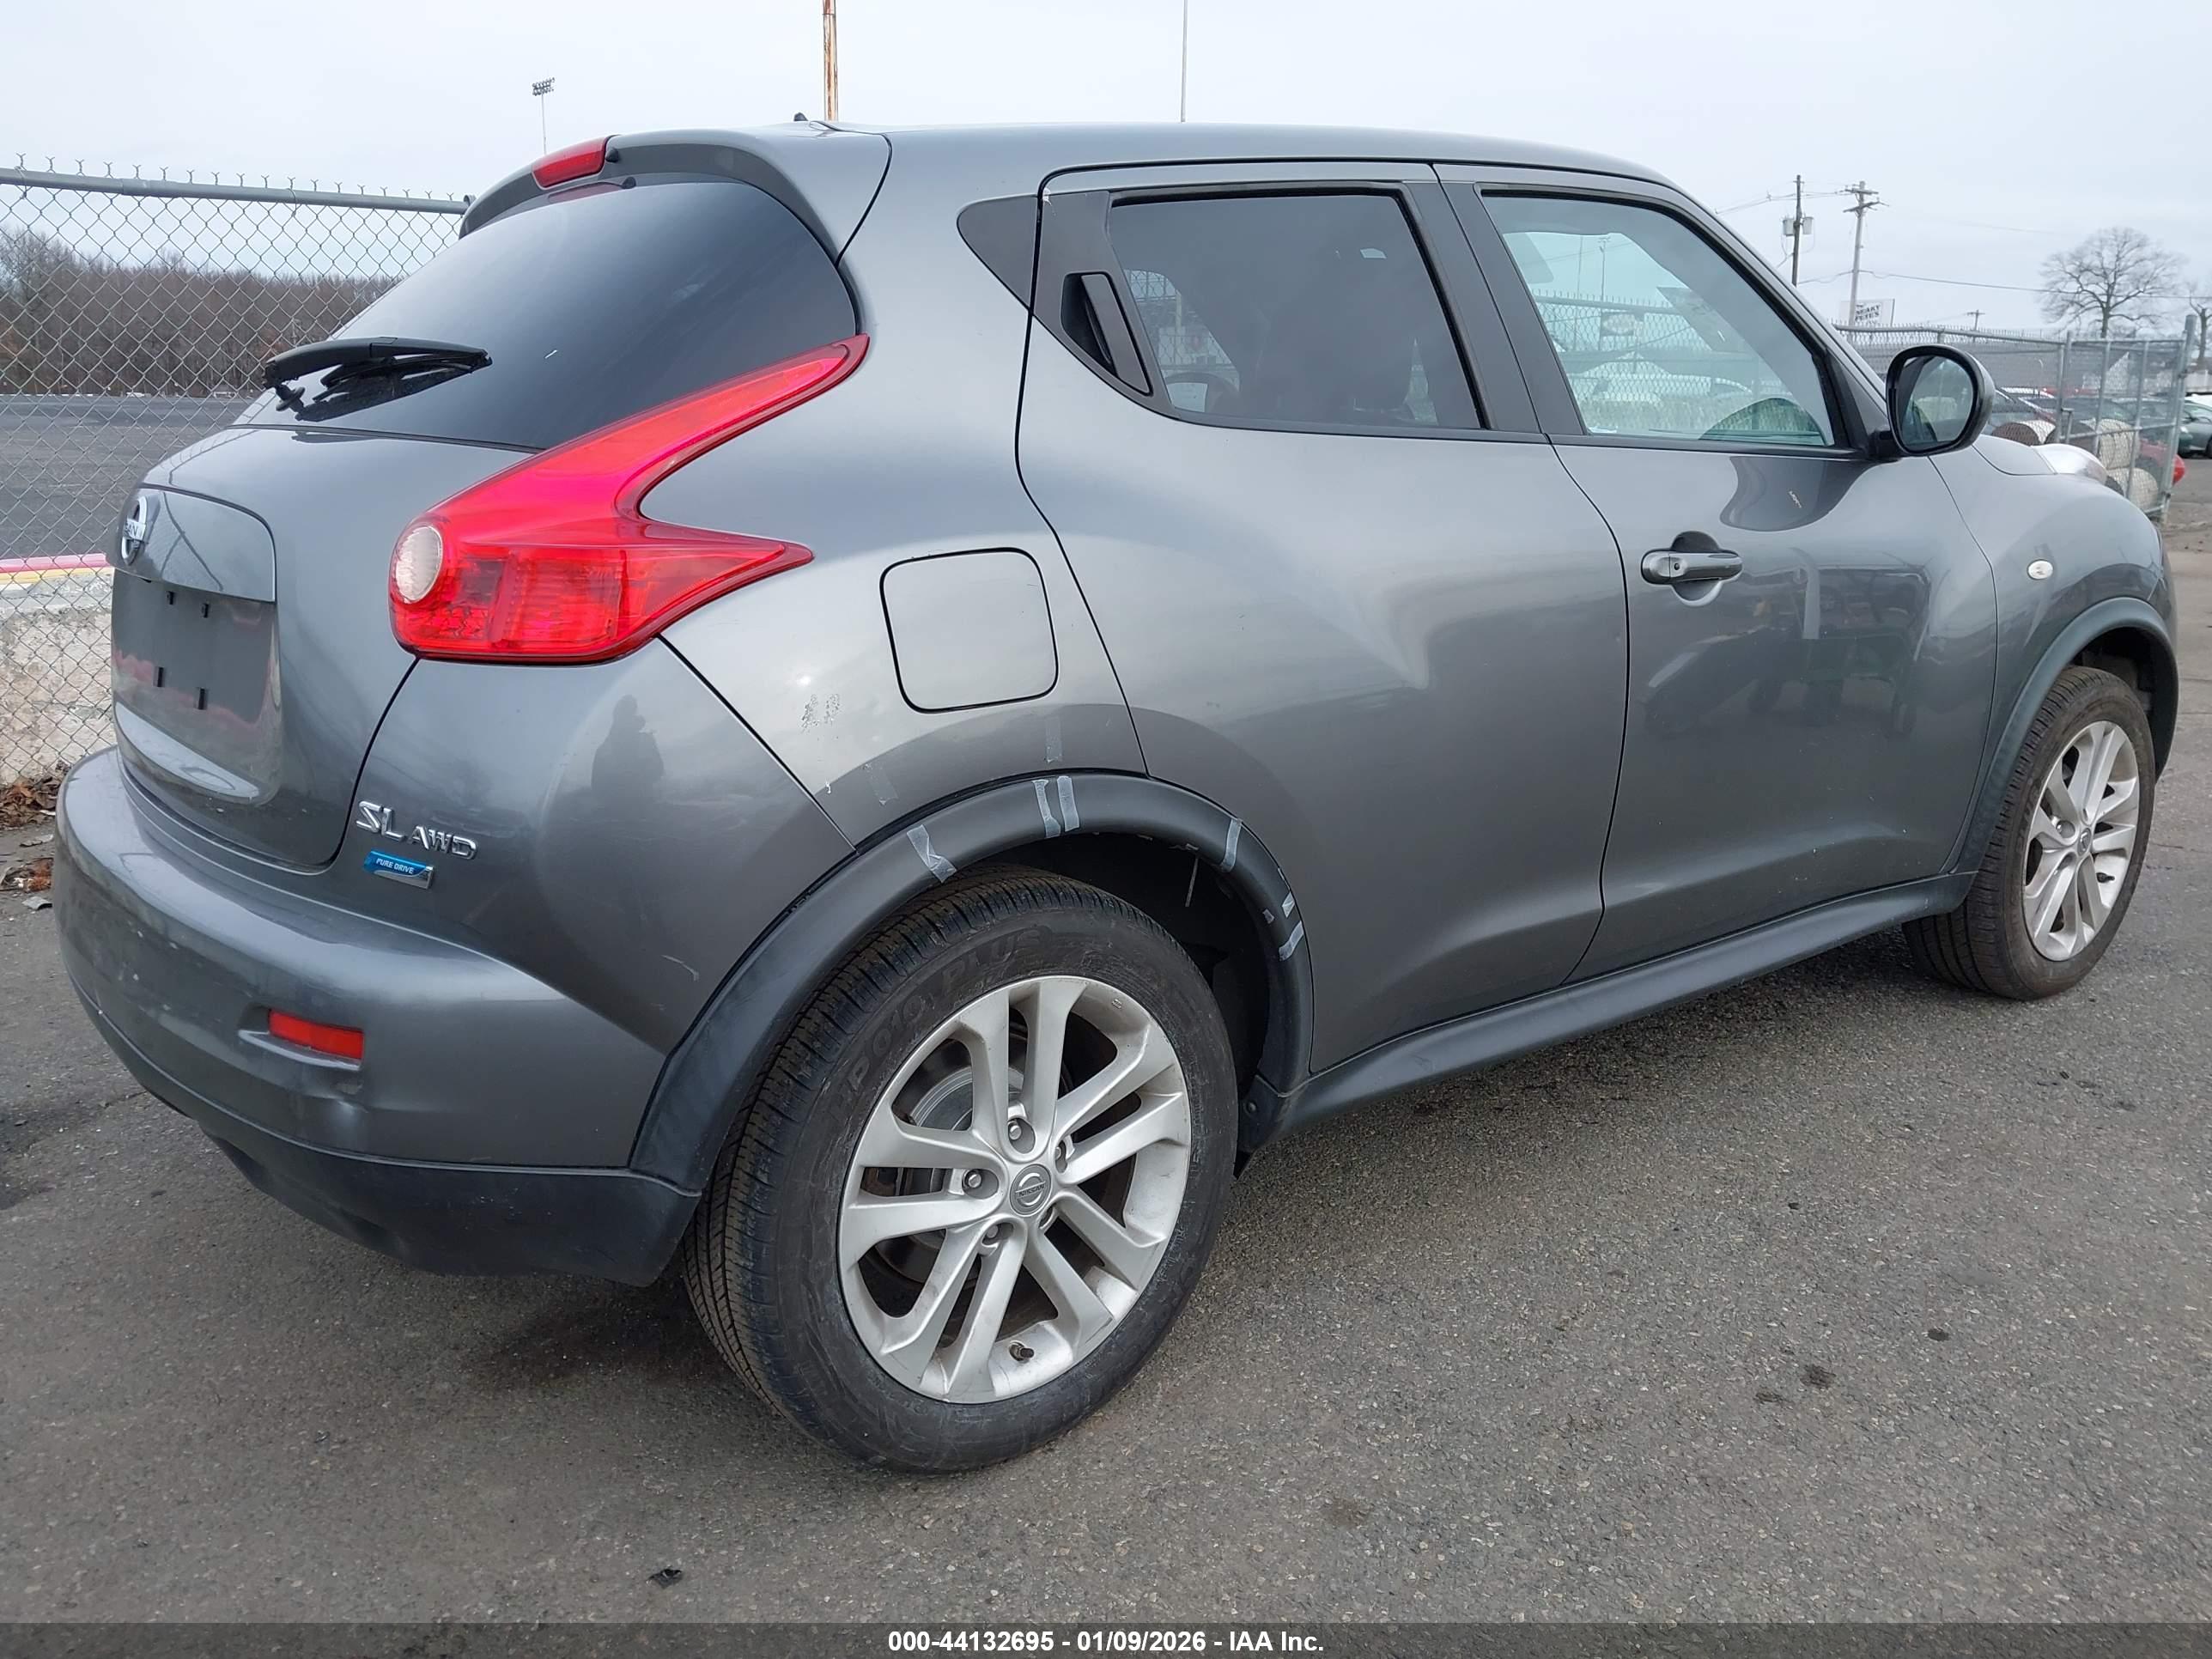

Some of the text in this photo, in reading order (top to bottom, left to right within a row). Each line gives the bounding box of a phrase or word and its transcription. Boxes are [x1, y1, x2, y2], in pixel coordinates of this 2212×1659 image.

[356, 800, 478, 860] SL AWD
[376, 858, 415, 874] PURE DRIVE
[1018, 1182, 1046, 1197] NISSAN
